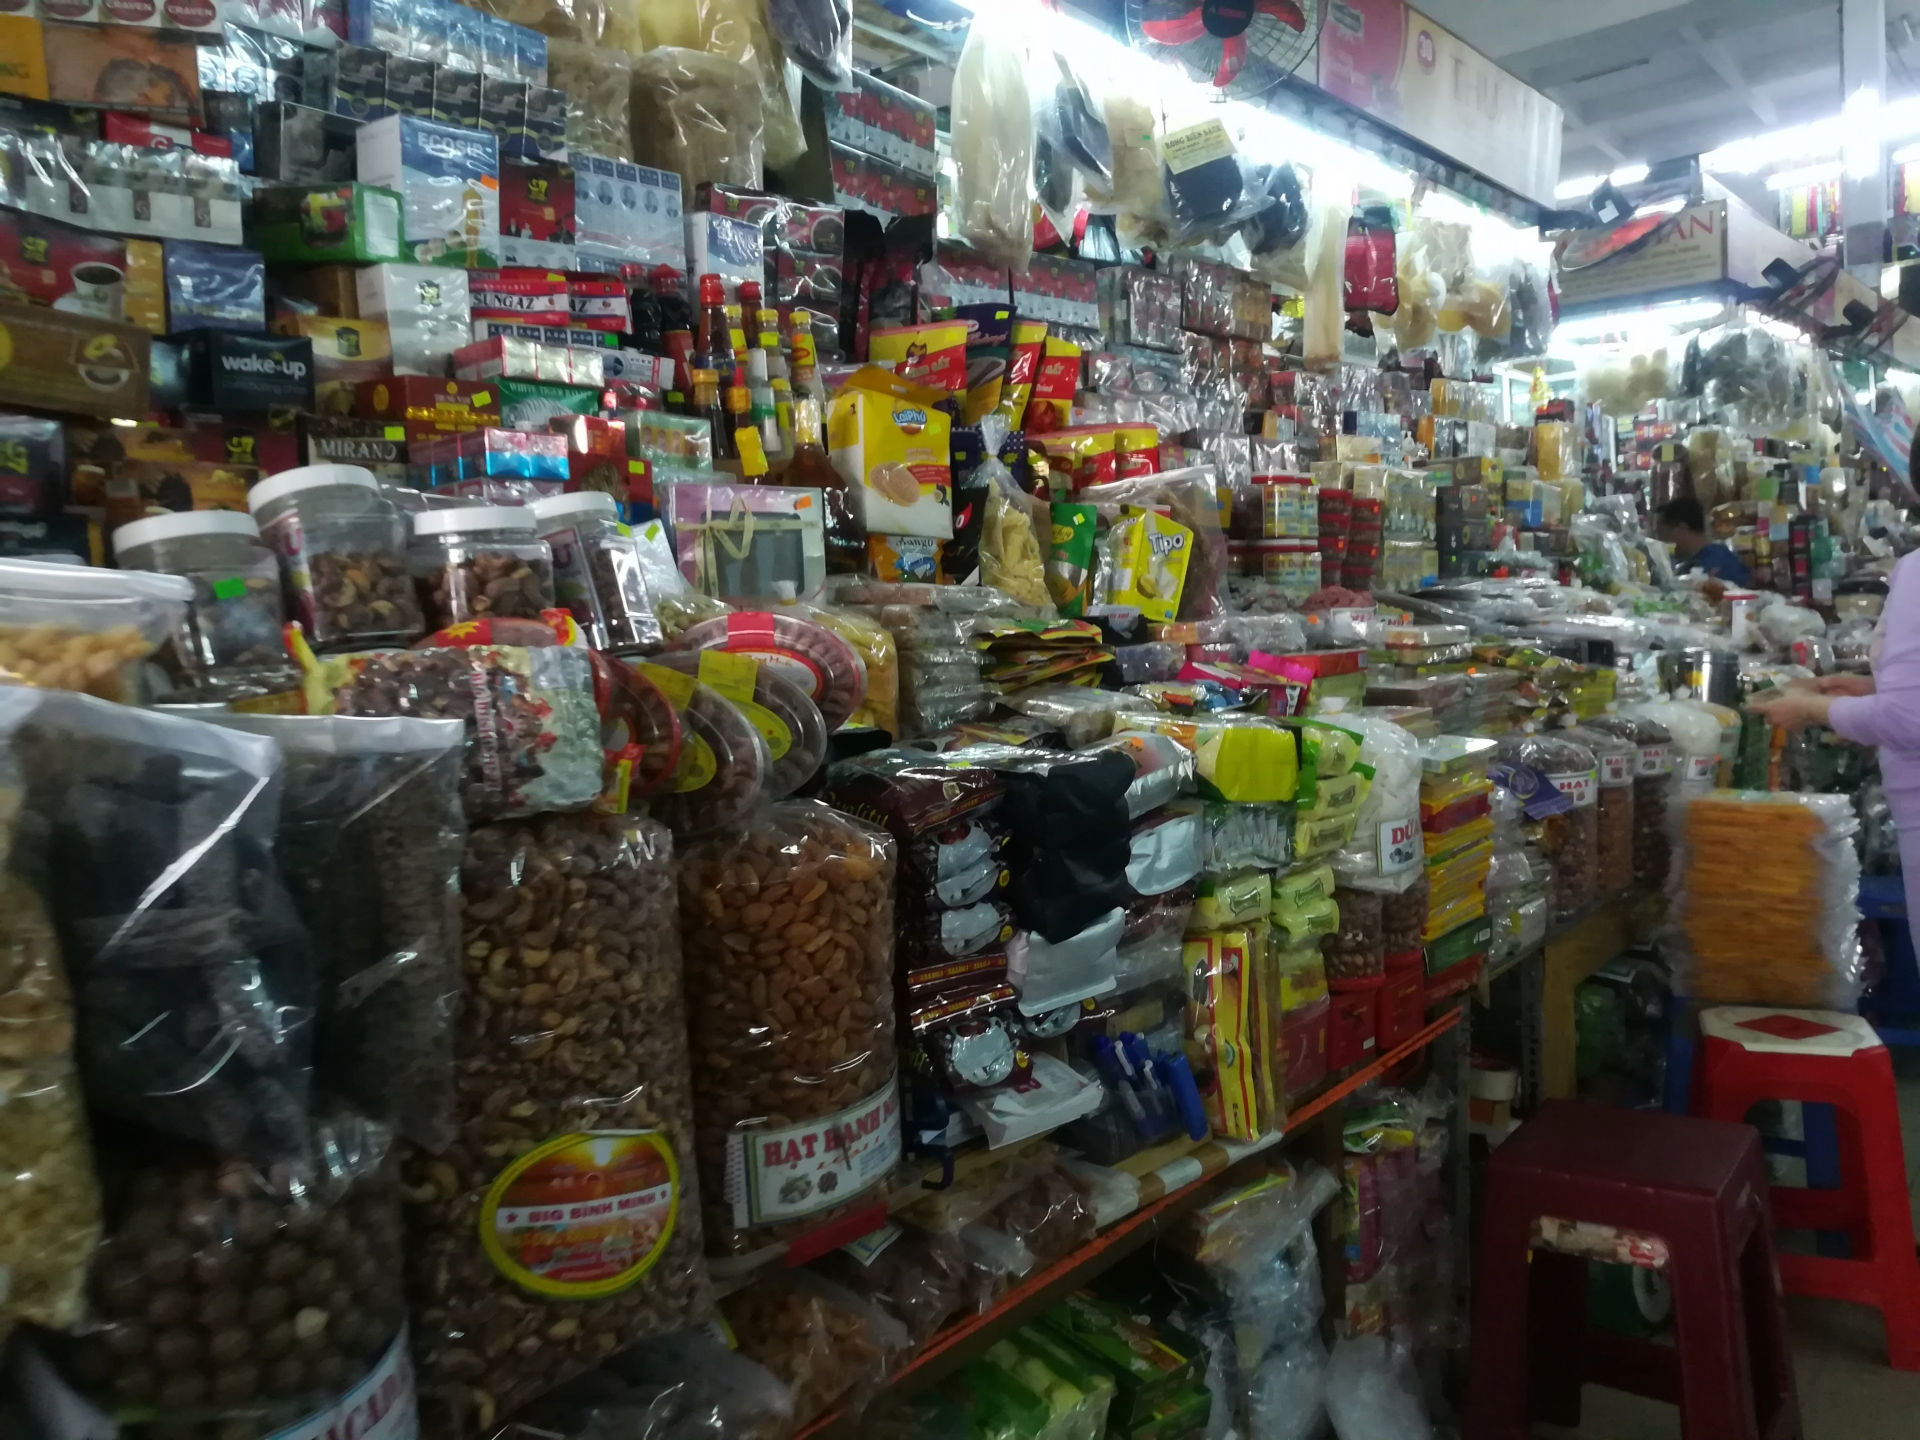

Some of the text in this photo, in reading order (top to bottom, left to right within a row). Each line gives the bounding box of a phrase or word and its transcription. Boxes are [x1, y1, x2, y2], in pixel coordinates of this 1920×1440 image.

[474, 292, 535, 311] SUNGAZ
[221, 352, 307, 381] wake-up
[1149, 533, 1184, 558] Tipo
[762, 1132, 819, 1171] HẠT
